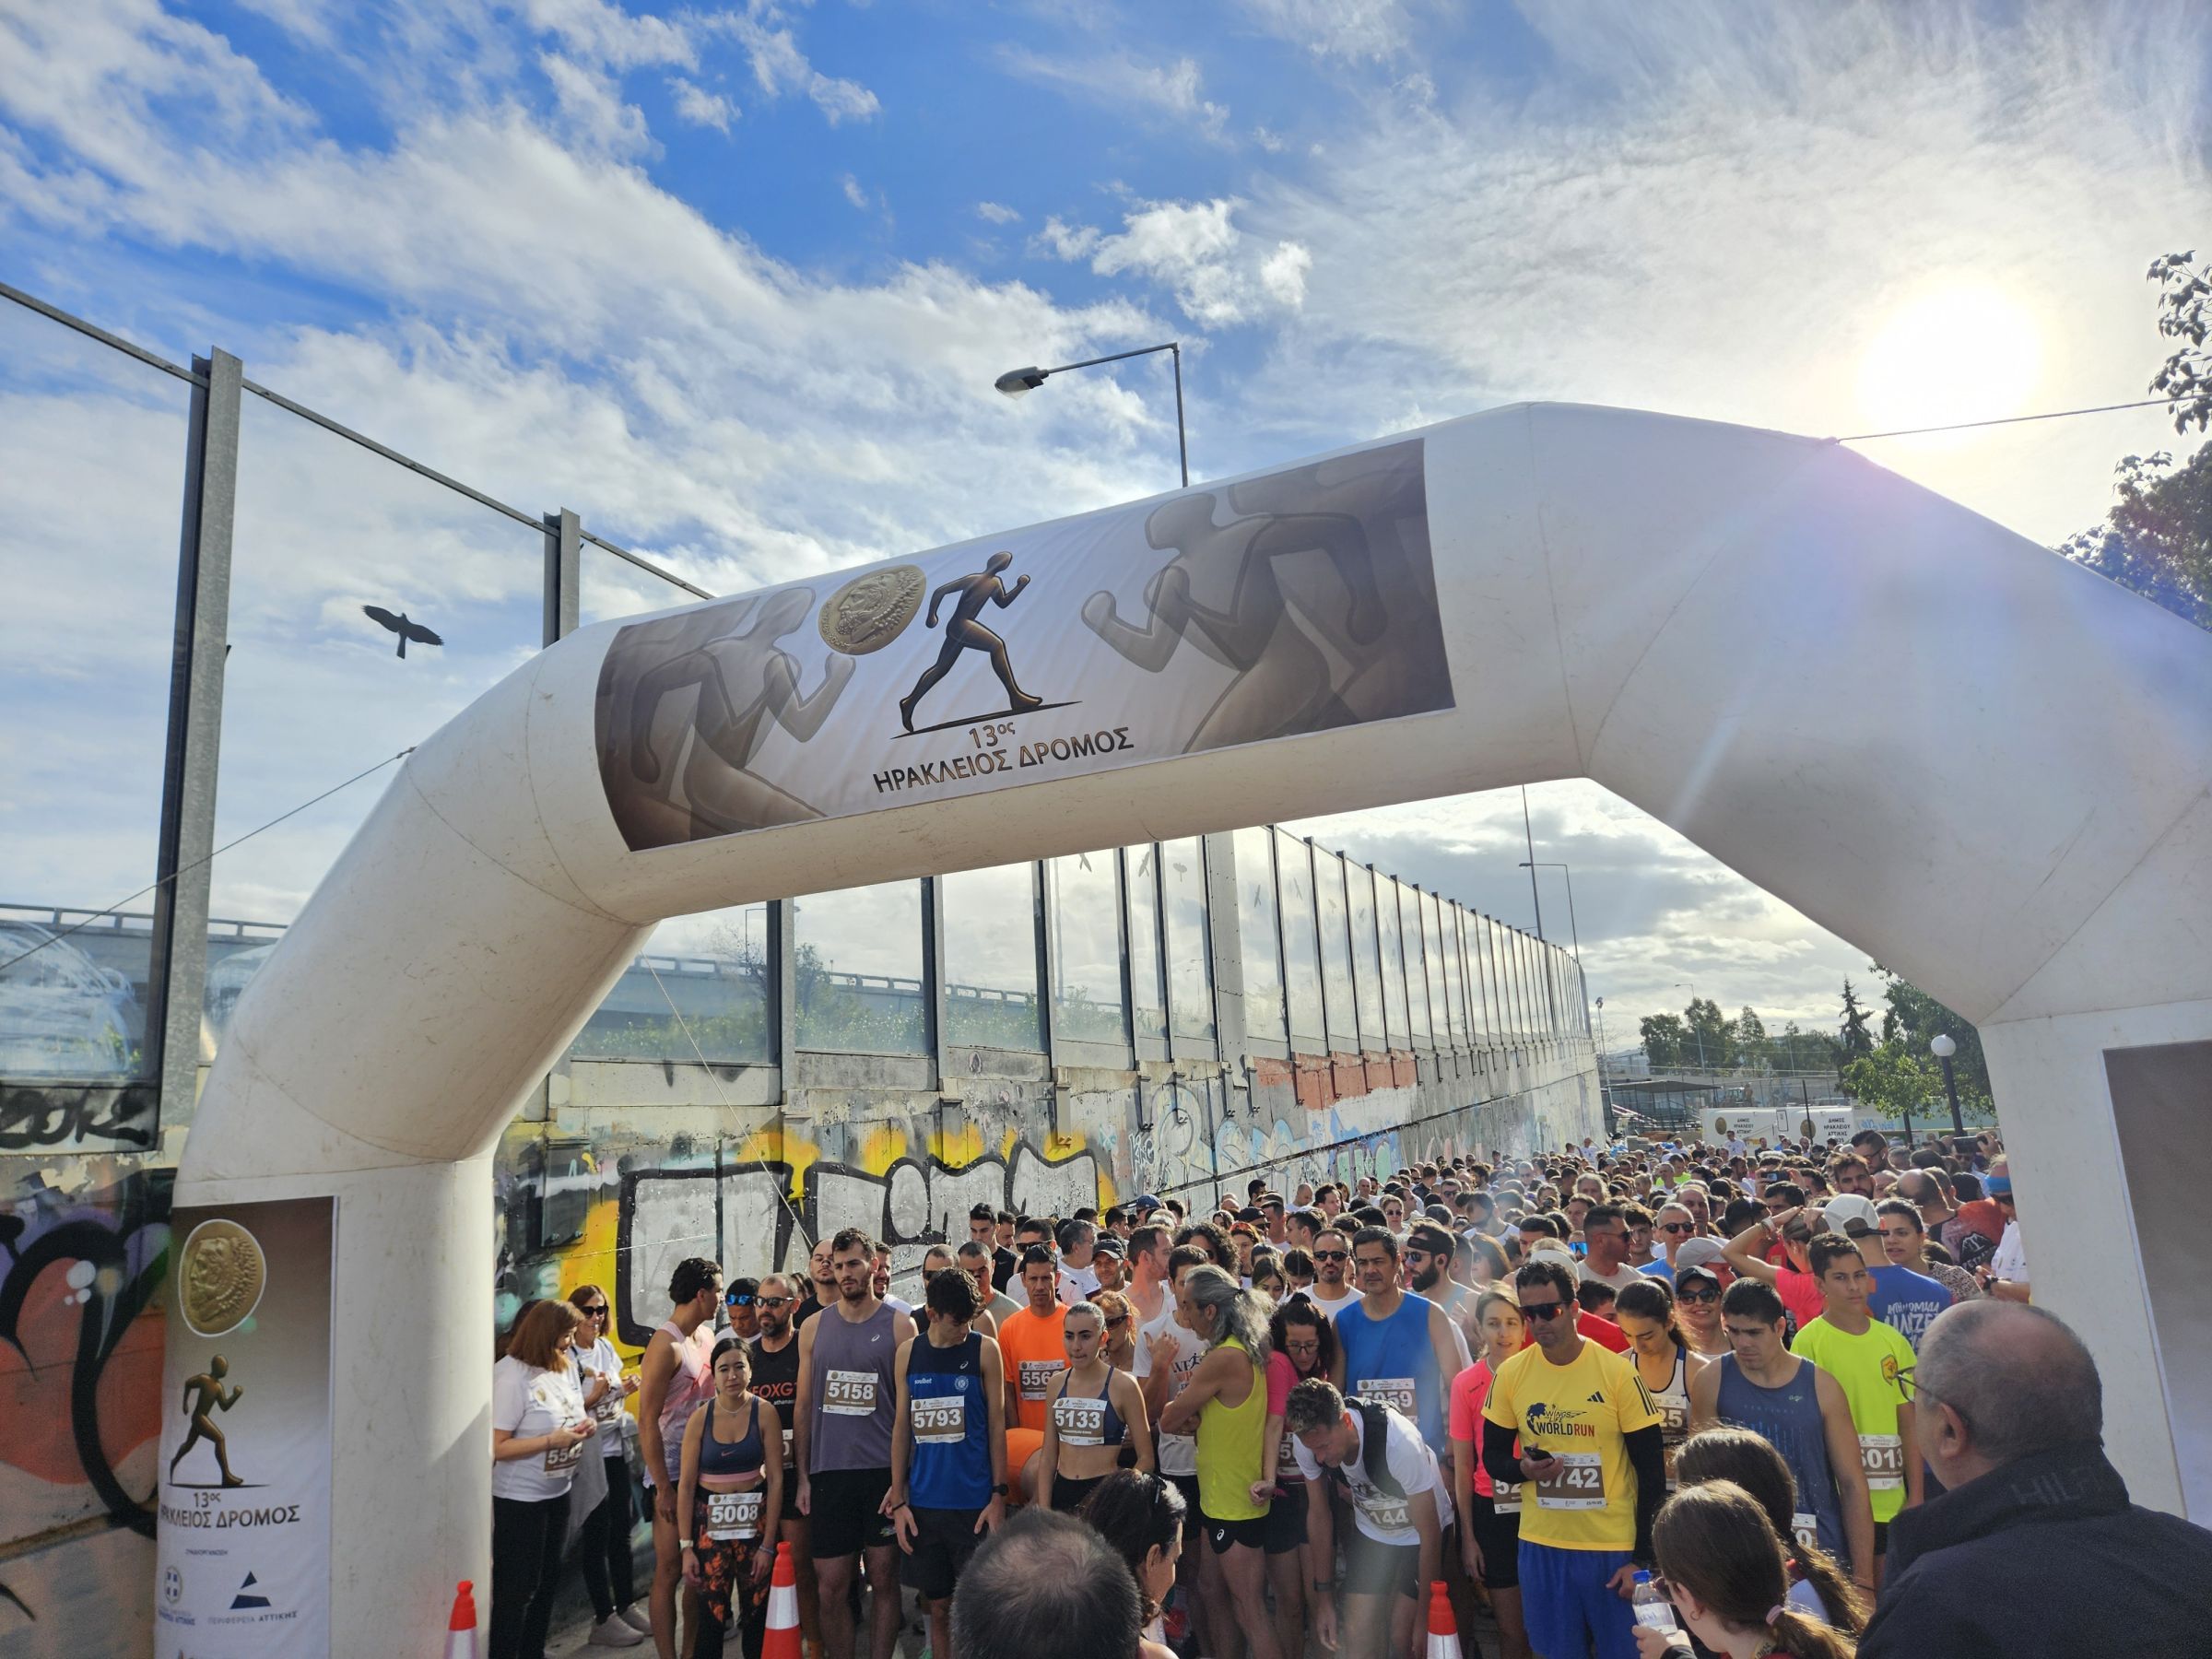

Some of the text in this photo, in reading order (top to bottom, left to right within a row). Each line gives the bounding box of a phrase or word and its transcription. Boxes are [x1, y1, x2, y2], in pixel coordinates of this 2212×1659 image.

[969, 722, 1016, 749] 13ος
[873, 726, 1135, 794] ΗΡΑΚΛΕΙΟΣ ΔΡΟΜΟΣ
[1021, 1371, 1062, 1386] 556
[828, 1382, 874, 1400] 5158
[913, 1408, 961, 1428] 5793
[1054, 1409, 1100, 1429] 5133
[194, 1491, 221, 1508] 13ος
[216, 1504, 300, 1528] ΔΡΟΜΟΣ
[711, 1504, 759, 1524] 5008
[1370, 1508, 1409, 1525] 144
[258, 1610, 299, 1623] ΑΤΤΙΚΗΣ
